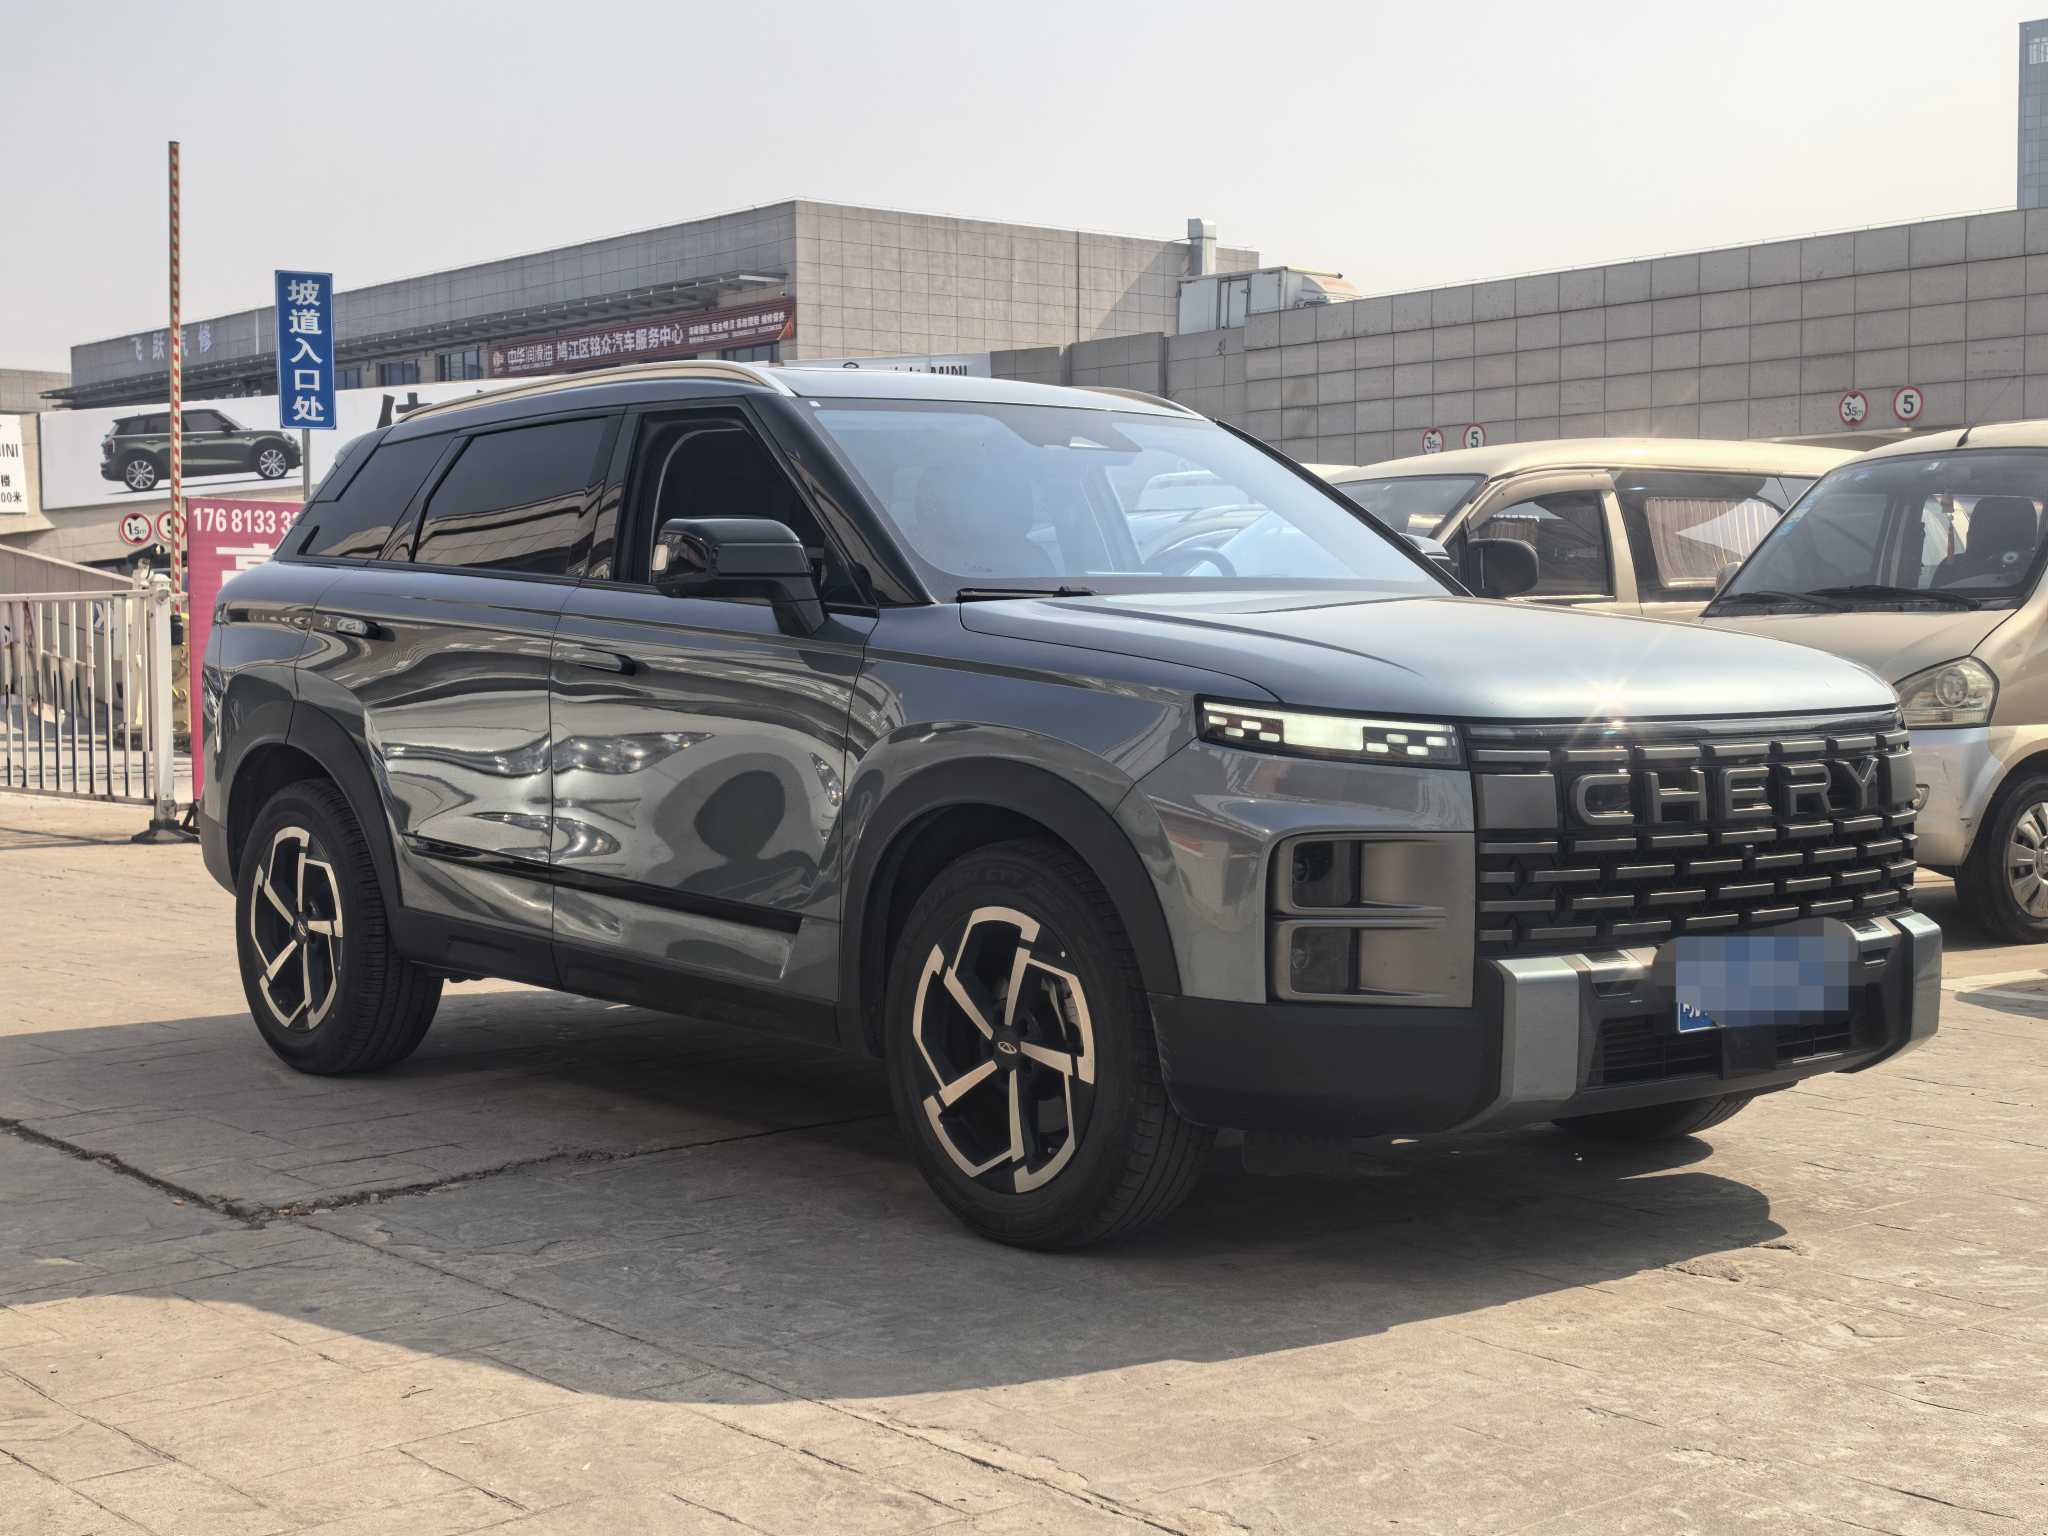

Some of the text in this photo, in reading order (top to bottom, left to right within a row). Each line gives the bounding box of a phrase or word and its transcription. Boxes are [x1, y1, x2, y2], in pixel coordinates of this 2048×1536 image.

[287, 279, 325, 422] 坡道入口处
[1903, 394, 1914, 414] 5
[0, 443, 19, 458] INI
[1470, 430, 1479, 449] 5
[193, 507, 227, 532] 176
[231, 509, 276, 534] 8133
[280, 511, 300, 534] 3
[1576, 756, 1880, 826] CHERY
